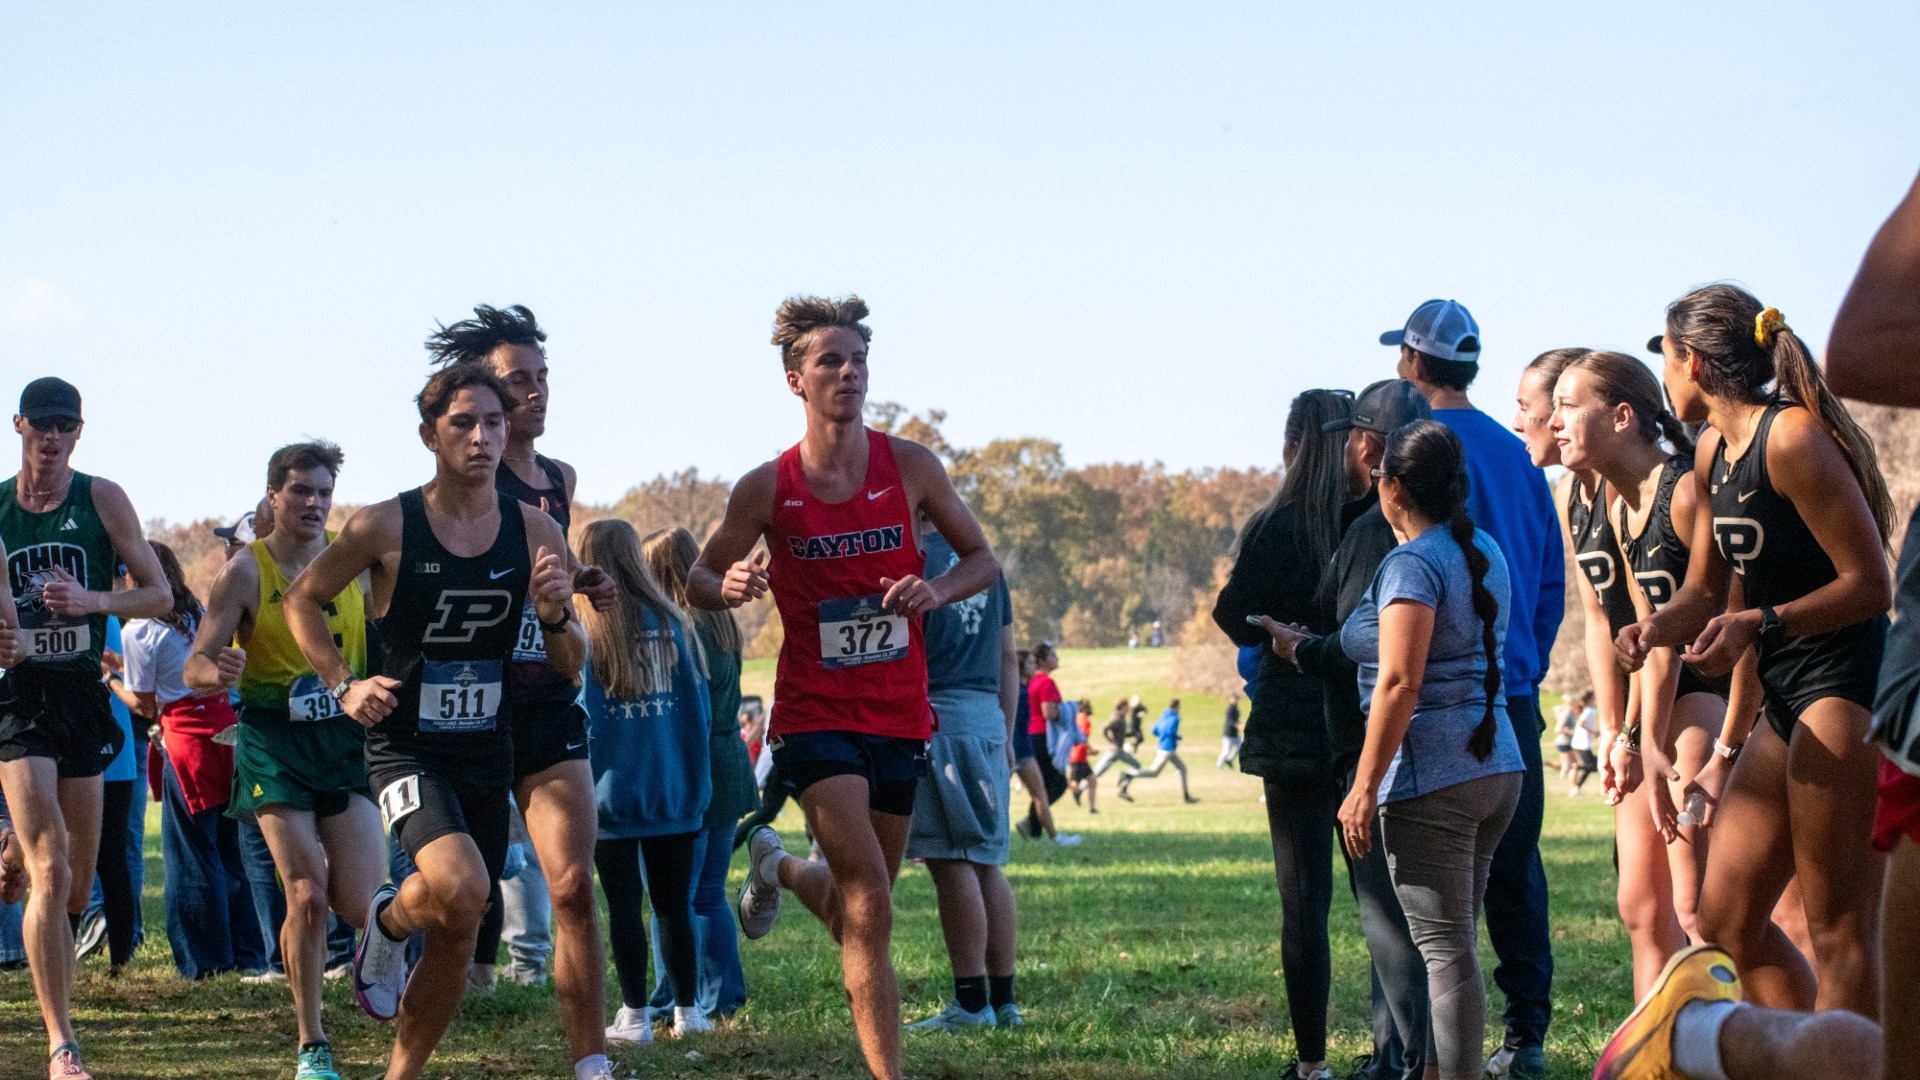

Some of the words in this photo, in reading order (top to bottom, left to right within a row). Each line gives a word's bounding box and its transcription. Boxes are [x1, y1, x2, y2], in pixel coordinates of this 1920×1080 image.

[422, 589, 513, 643] P
[34, 630, 77, 655] 500
[839, 620, 894, 655] 372
[304, 694, 345, 721] 391
[440, 688, 485, 719] 511
